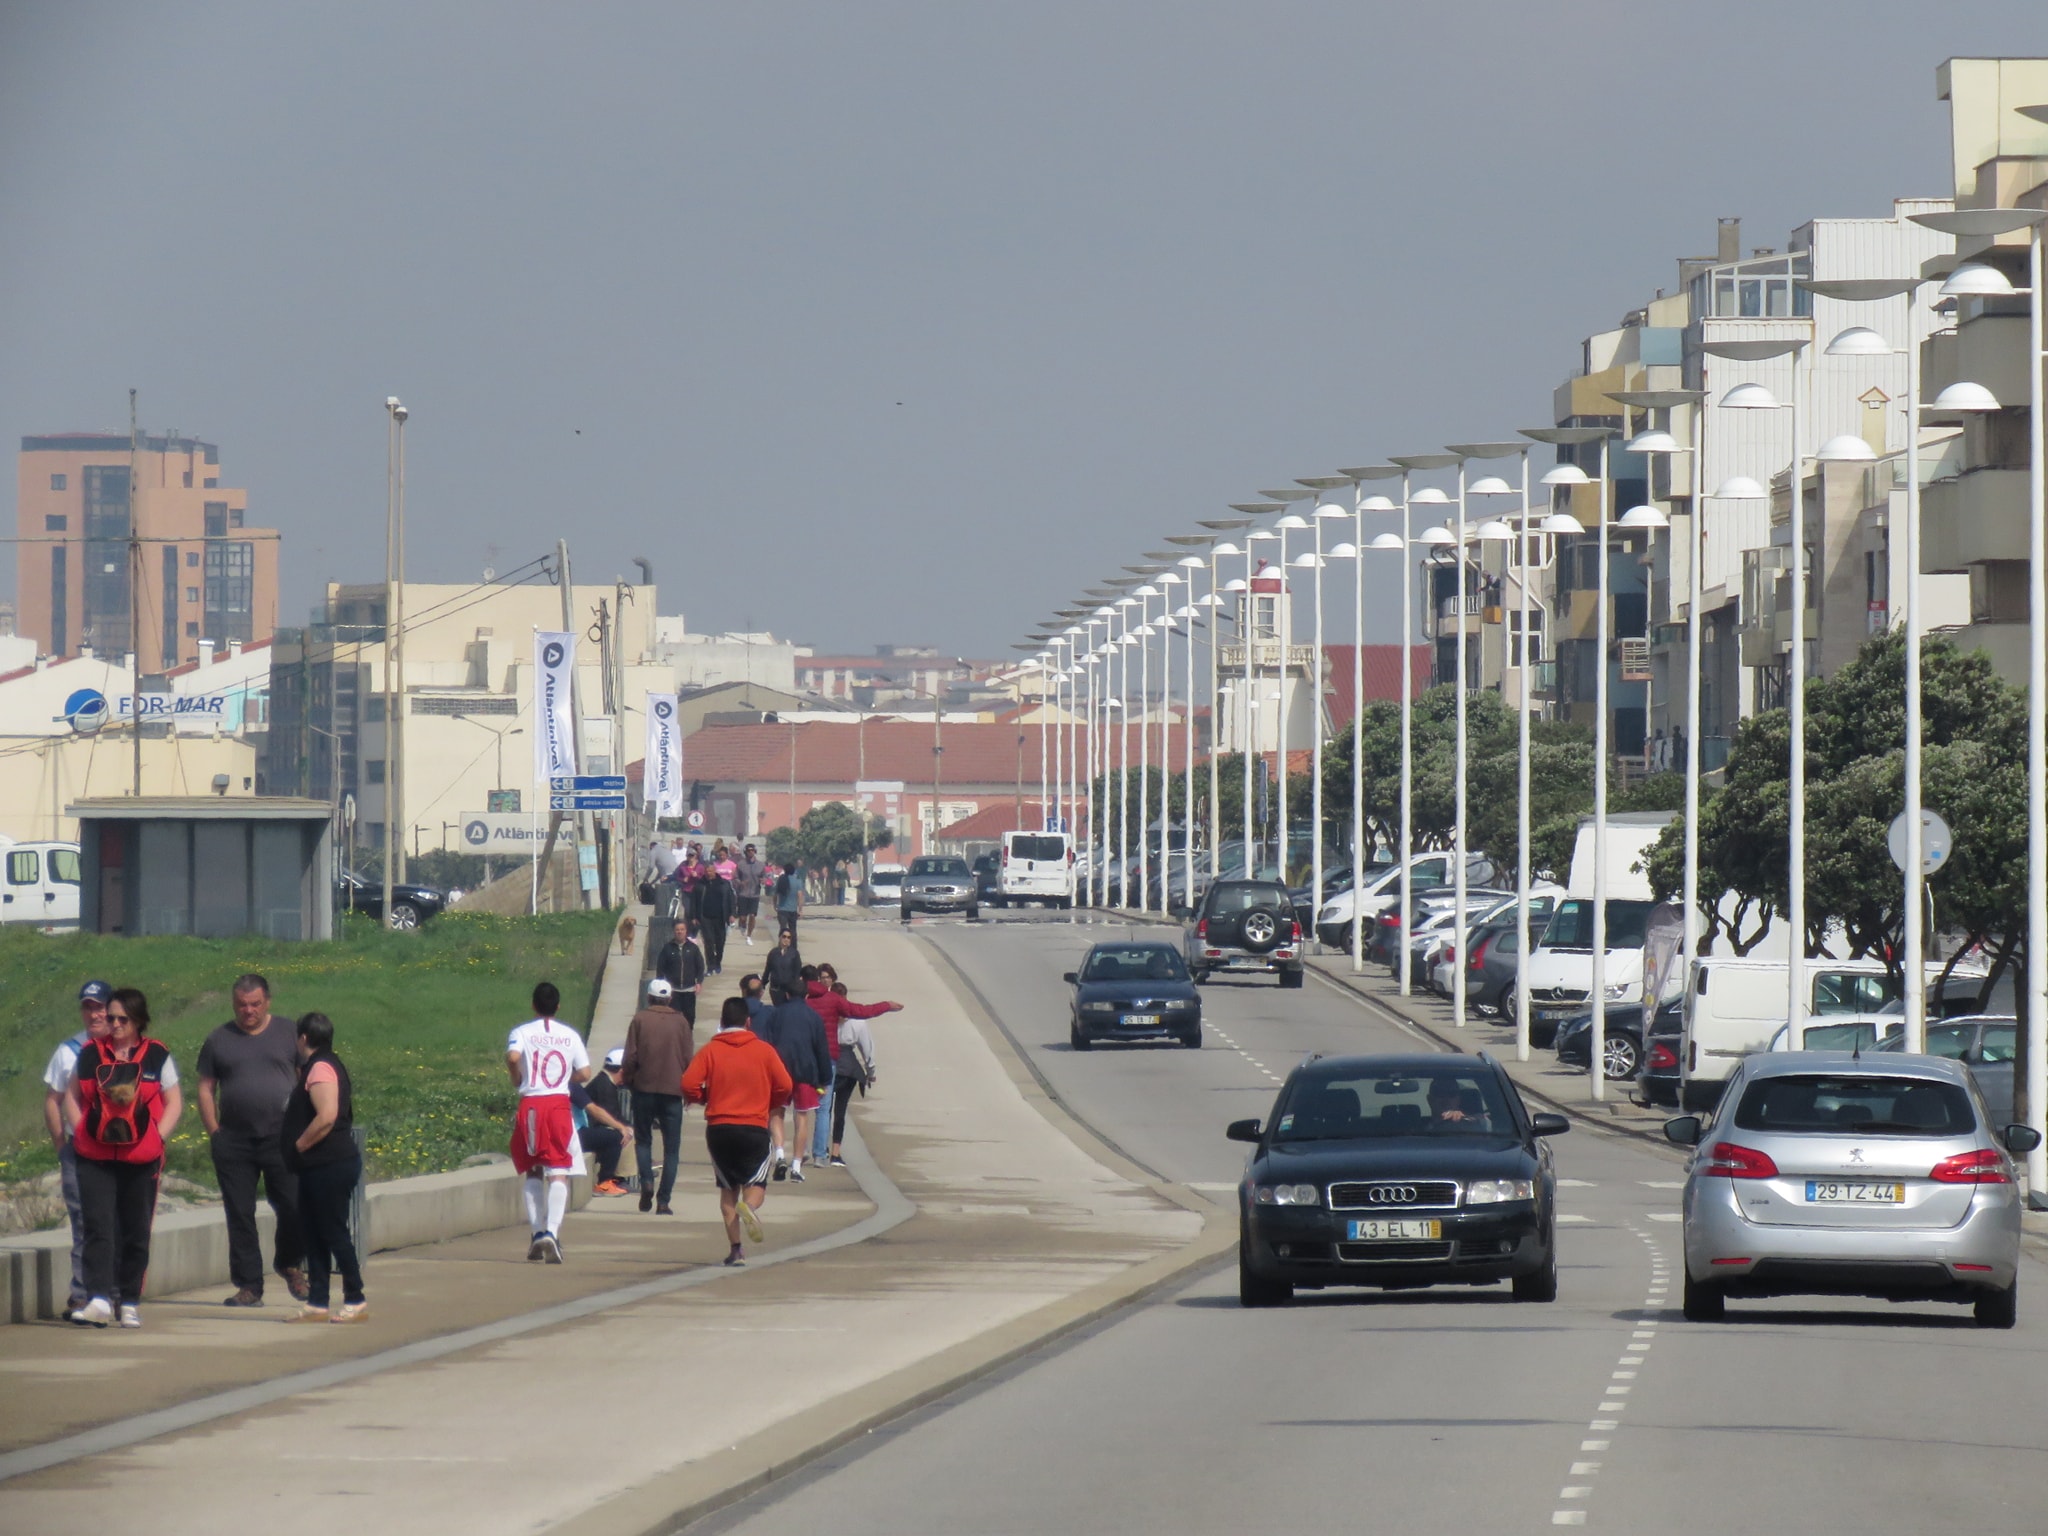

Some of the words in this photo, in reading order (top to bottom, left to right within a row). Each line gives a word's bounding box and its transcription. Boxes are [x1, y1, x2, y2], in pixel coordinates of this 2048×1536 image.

[119, 697, 224, 714] FOR-MAR
[531, 1035, 571, 1047] GUSTAVO
[530, 1049, 567, 1089] 10
